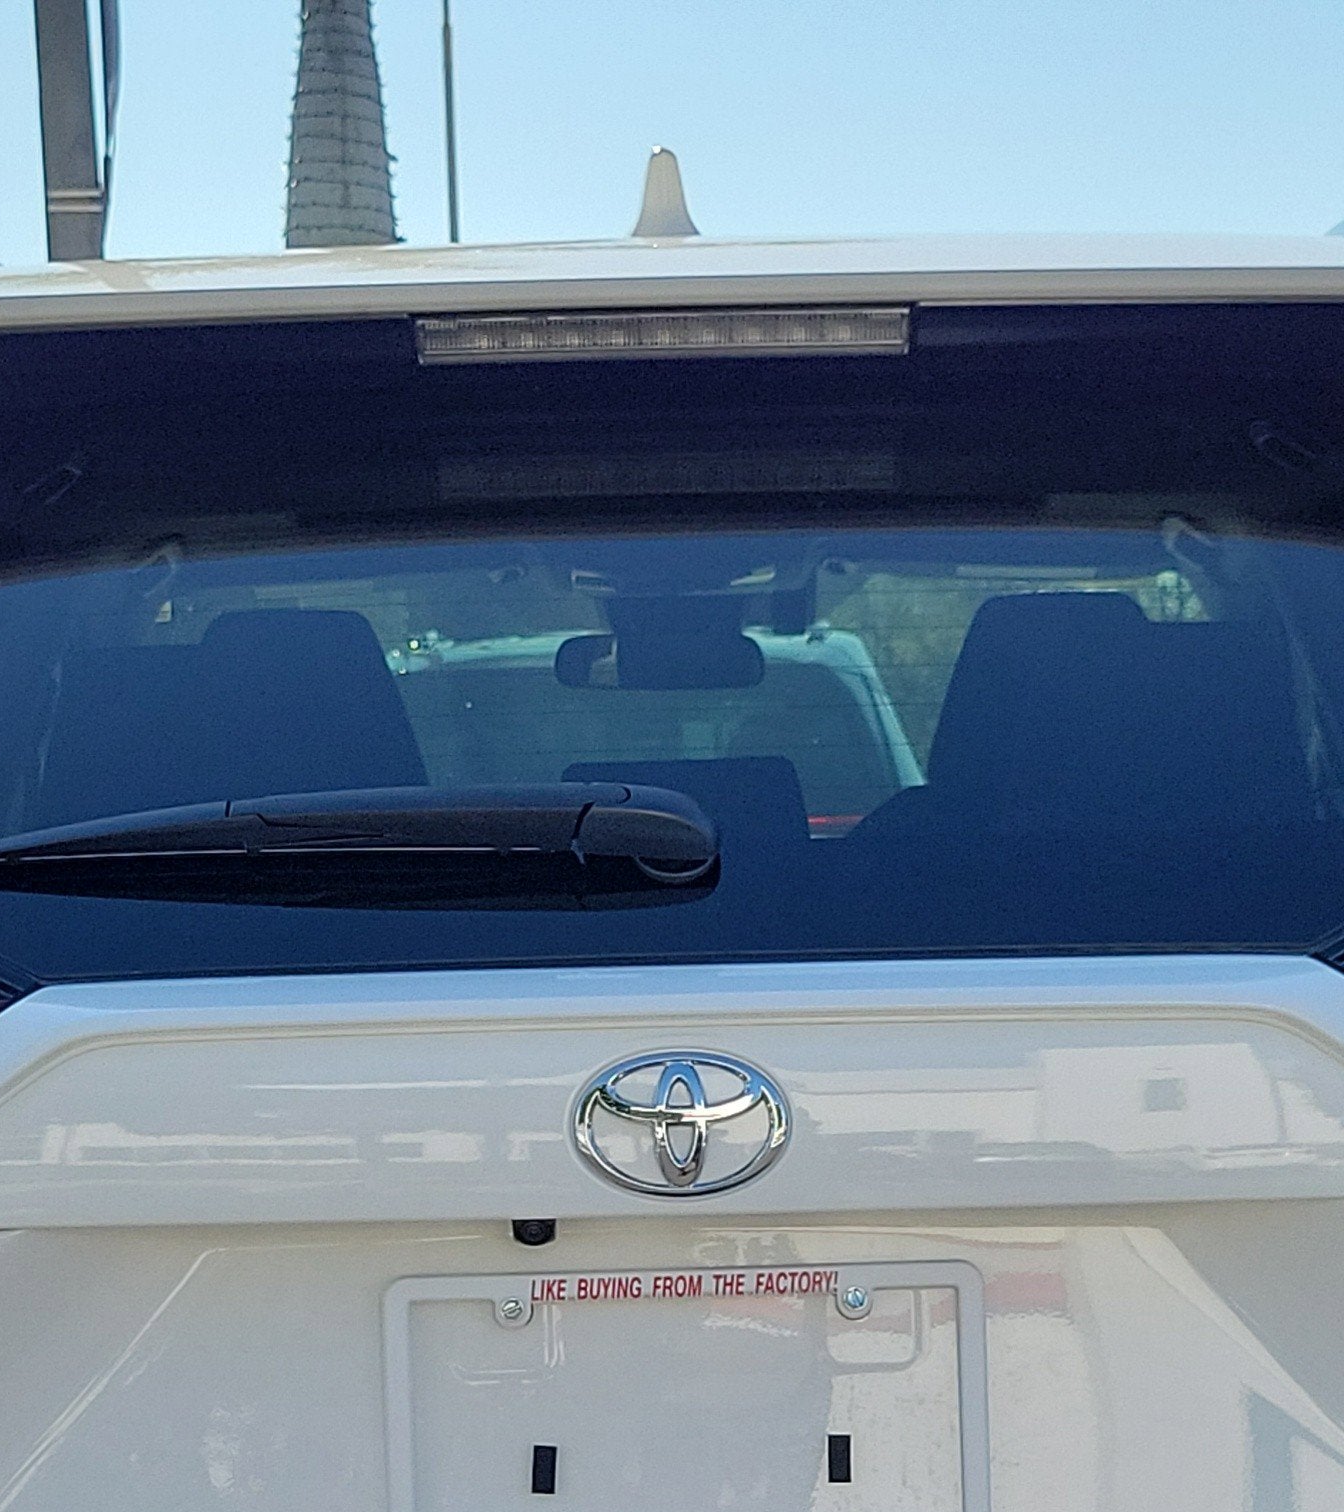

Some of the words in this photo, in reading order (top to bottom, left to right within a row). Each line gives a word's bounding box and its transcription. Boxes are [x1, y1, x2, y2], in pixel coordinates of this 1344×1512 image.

[531, 1279, 567, 1301] LIKE
[577, 1277, 642, 1300] BUYING
[652, 1275, 702, 1298] FROM
[713, 1274, 746, 1296] THE
[755, 1271, 839, 1295] FACTORY!
